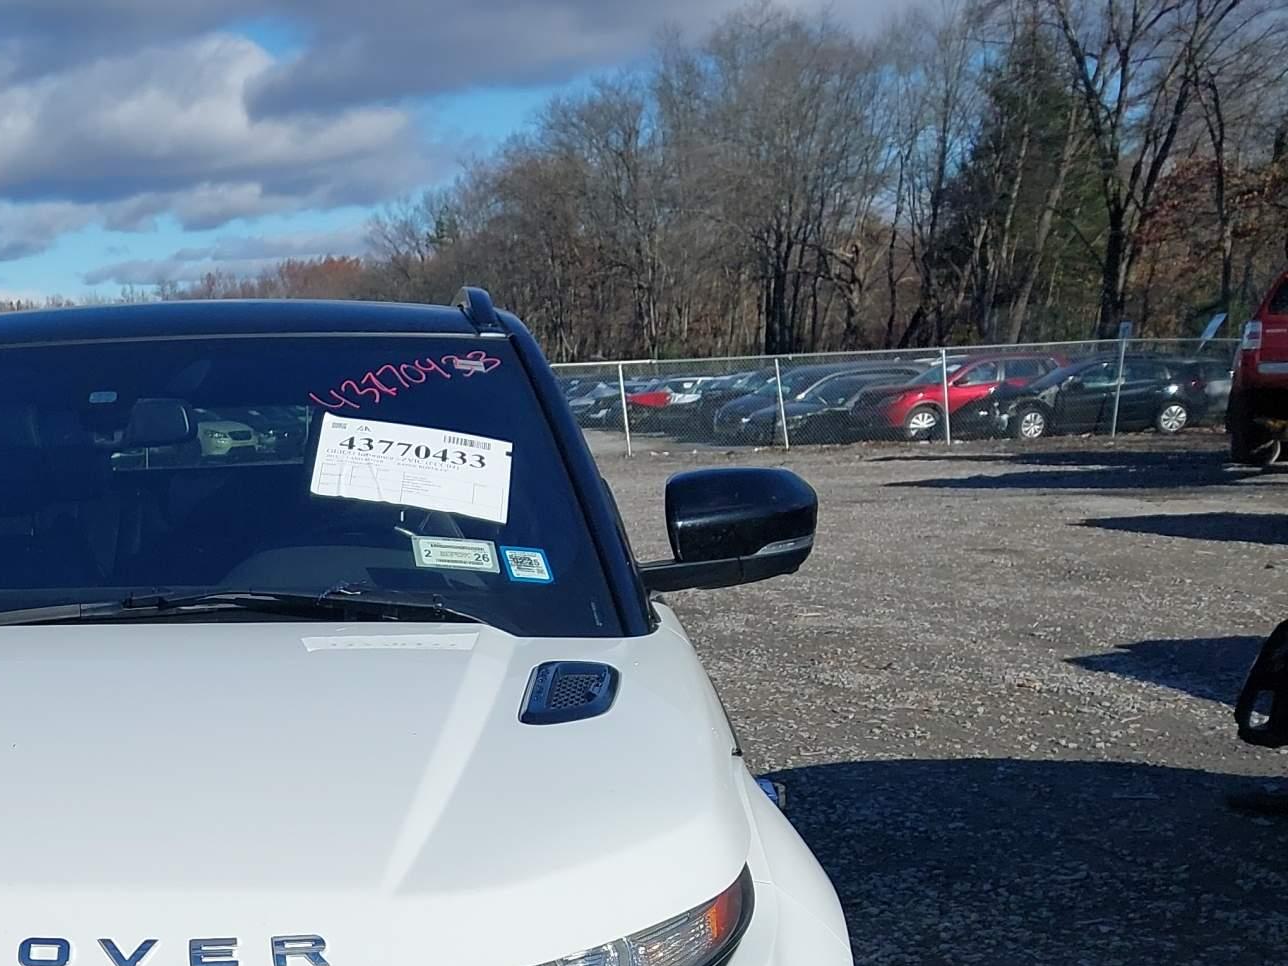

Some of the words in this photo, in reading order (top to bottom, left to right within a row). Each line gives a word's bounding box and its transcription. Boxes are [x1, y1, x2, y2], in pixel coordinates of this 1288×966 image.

[339, 436, 487, 469] 43770433
[424, 549, 432, 558] 2
[473, 552, 490, 563] 26
